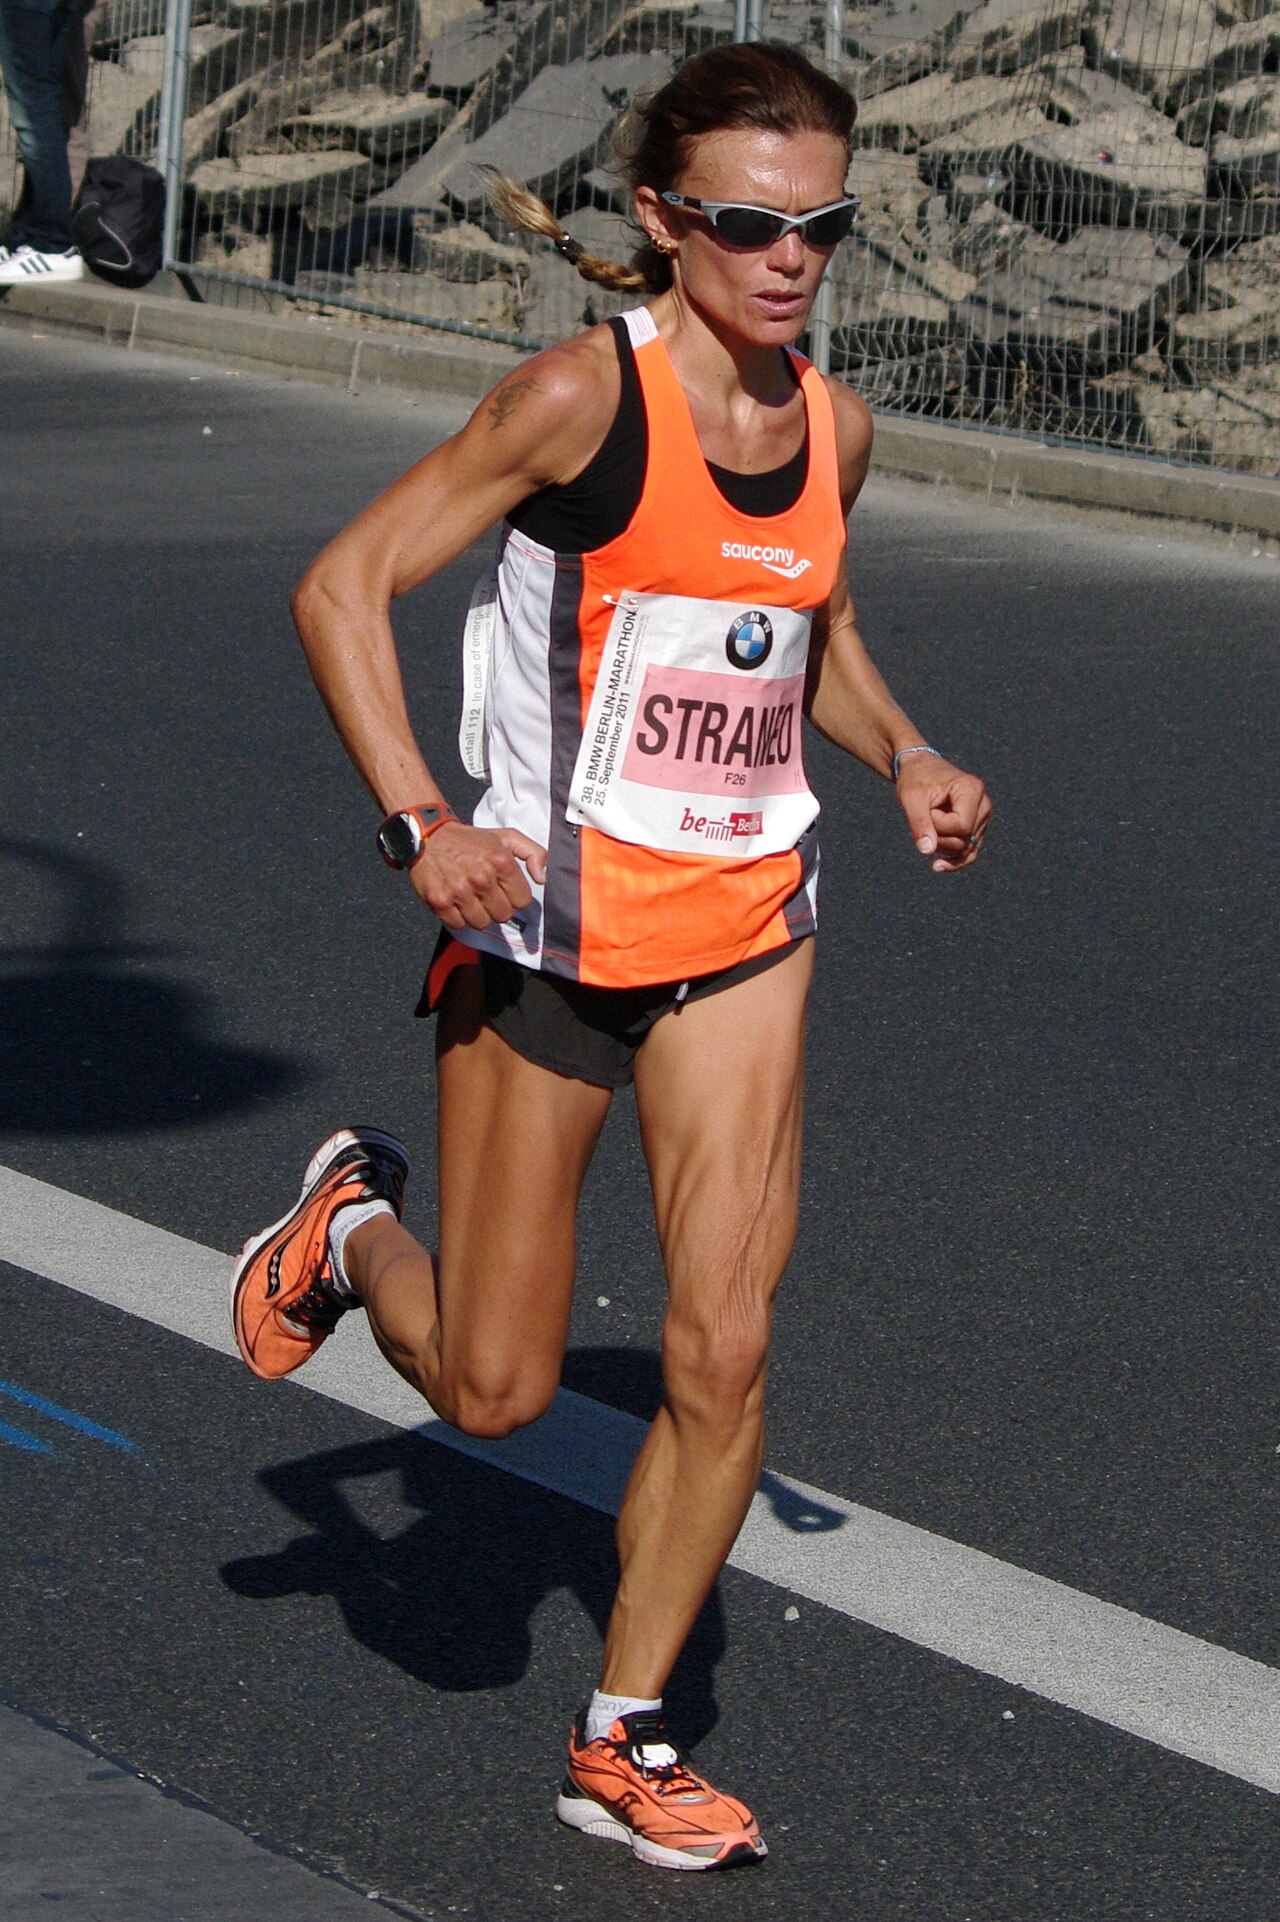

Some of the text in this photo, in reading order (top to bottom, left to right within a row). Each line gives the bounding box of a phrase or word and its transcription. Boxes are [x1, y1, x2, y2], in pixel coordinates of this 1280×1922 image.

[721, 541, 794, 567] saucony
[471, 648, 481, 661] of
[473, 663, 483, 690] case
[472, 691, 482, 702] In
[581, 611, 638, 804] 38. BMW BERLIN-MARATHON
[468, 708, 481, 729] 112
[636, 694, 794, 768] STRANEO
[465, 732, 476, 771] Notfall
[594, 692, 631, 807] 25. September 2011
[724, 773, 746, 786] F26
